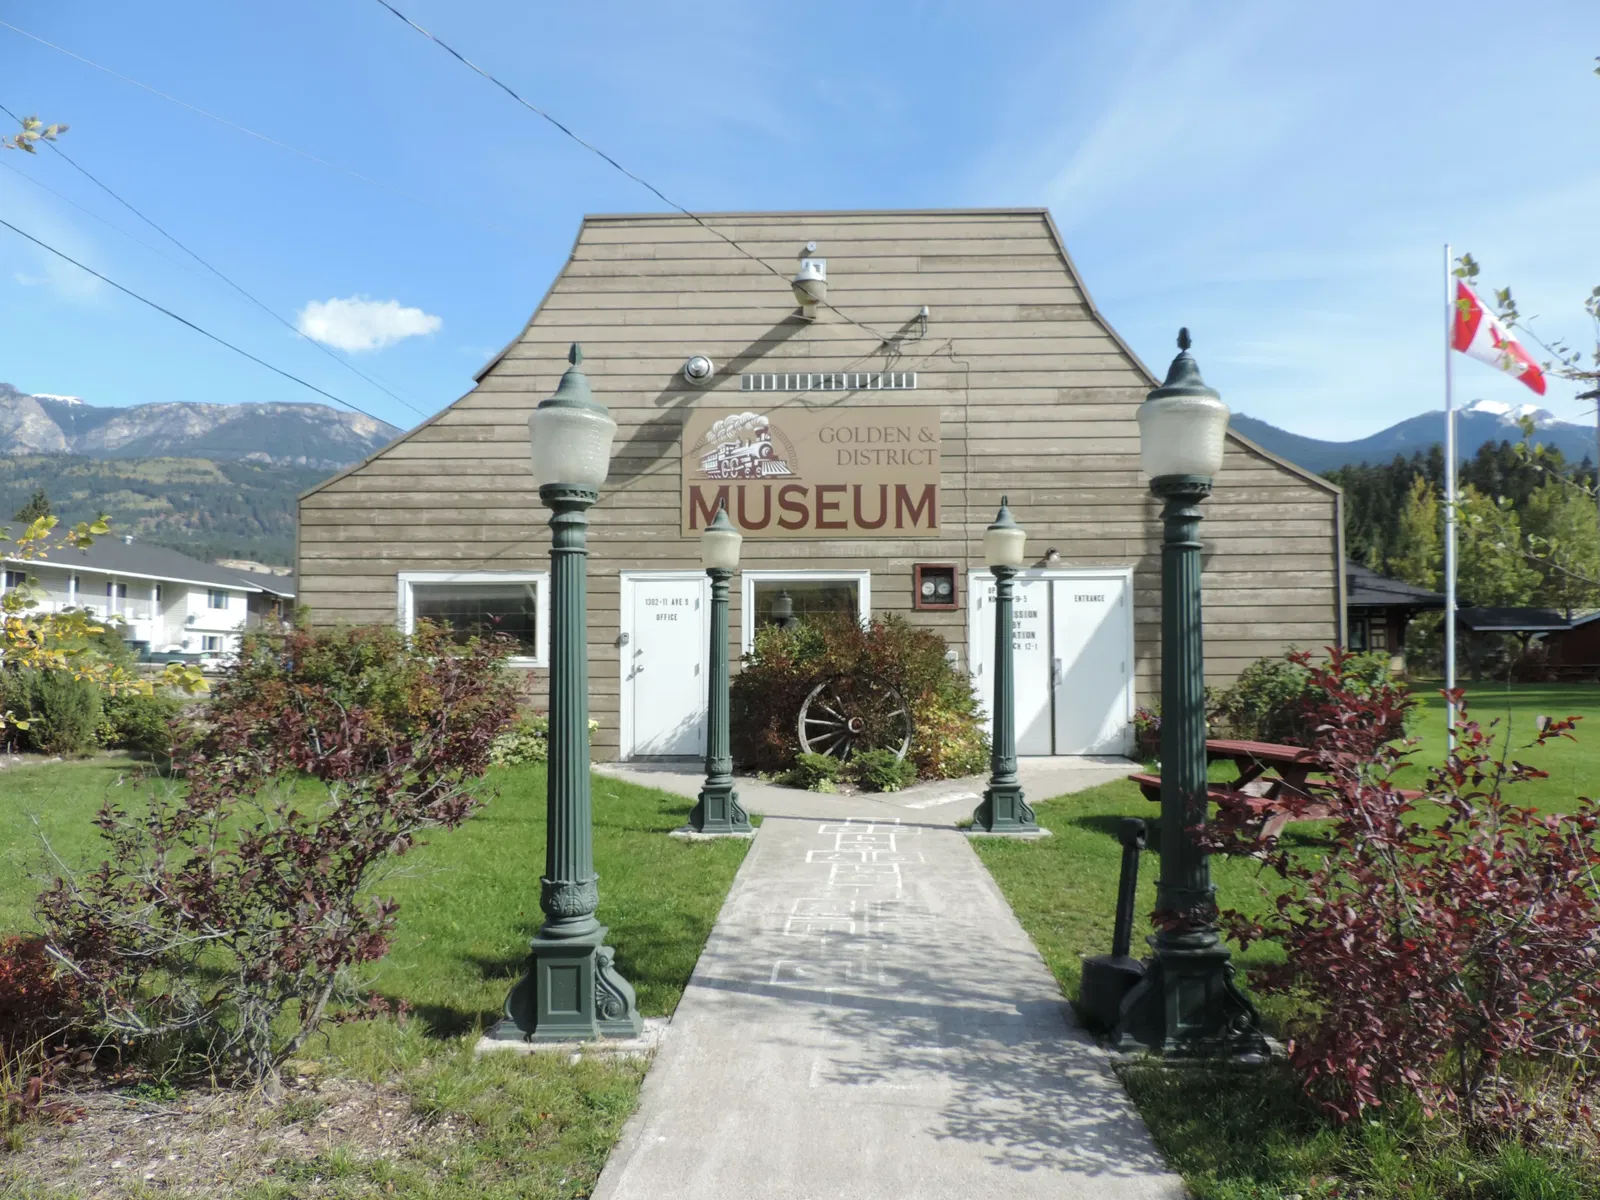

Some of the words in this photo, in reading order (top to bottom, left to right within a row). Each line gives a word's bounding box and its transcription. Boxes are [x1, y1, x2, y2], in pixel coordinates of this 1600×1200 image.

[818, 426, 912, 443] GOLDEN
[918, 426, 936, 443] &
[837, 448, 938, 466] DISTRICT
[688, 483, 938, 530] MUSEUM
[671, 598, 683, 606] AVE
[1074, 594, 1105, 602] ENTRANCE
[656, 613, 678, 621] OFFICE
[1014, 610, 1038, 619] SSION
[1012, 631, 1036, 640] ATION
